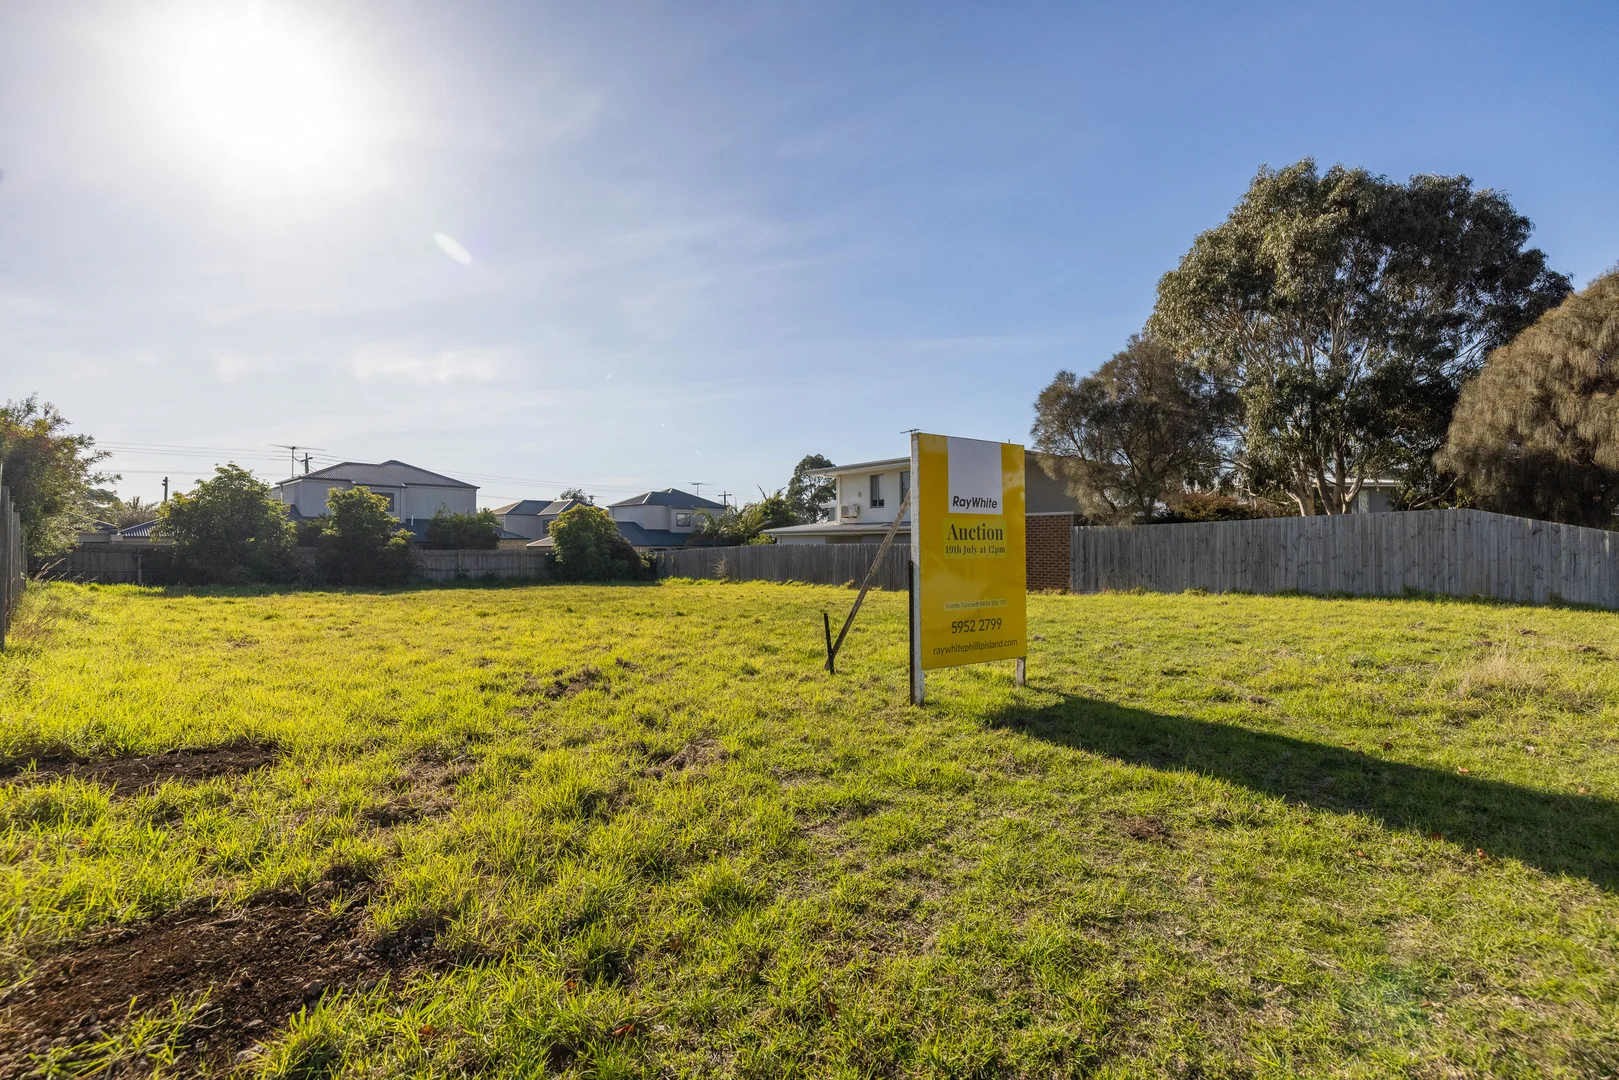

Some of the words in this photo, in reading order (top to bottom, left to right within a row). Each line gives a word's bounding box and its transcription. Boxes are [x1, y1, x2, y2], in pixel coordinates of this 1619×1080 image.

[947, 523, 1003, 540] Auction
[946, 545, 961, 554] 19th
[962, 545, 977, 555] July
[988, 545, 1006, 555] 12pm
[951, 620, 976, 634] 5952
[979, 618, 1003, 631] 2799
[933, 639, 1018, 656] raywhitephillipisland.com
